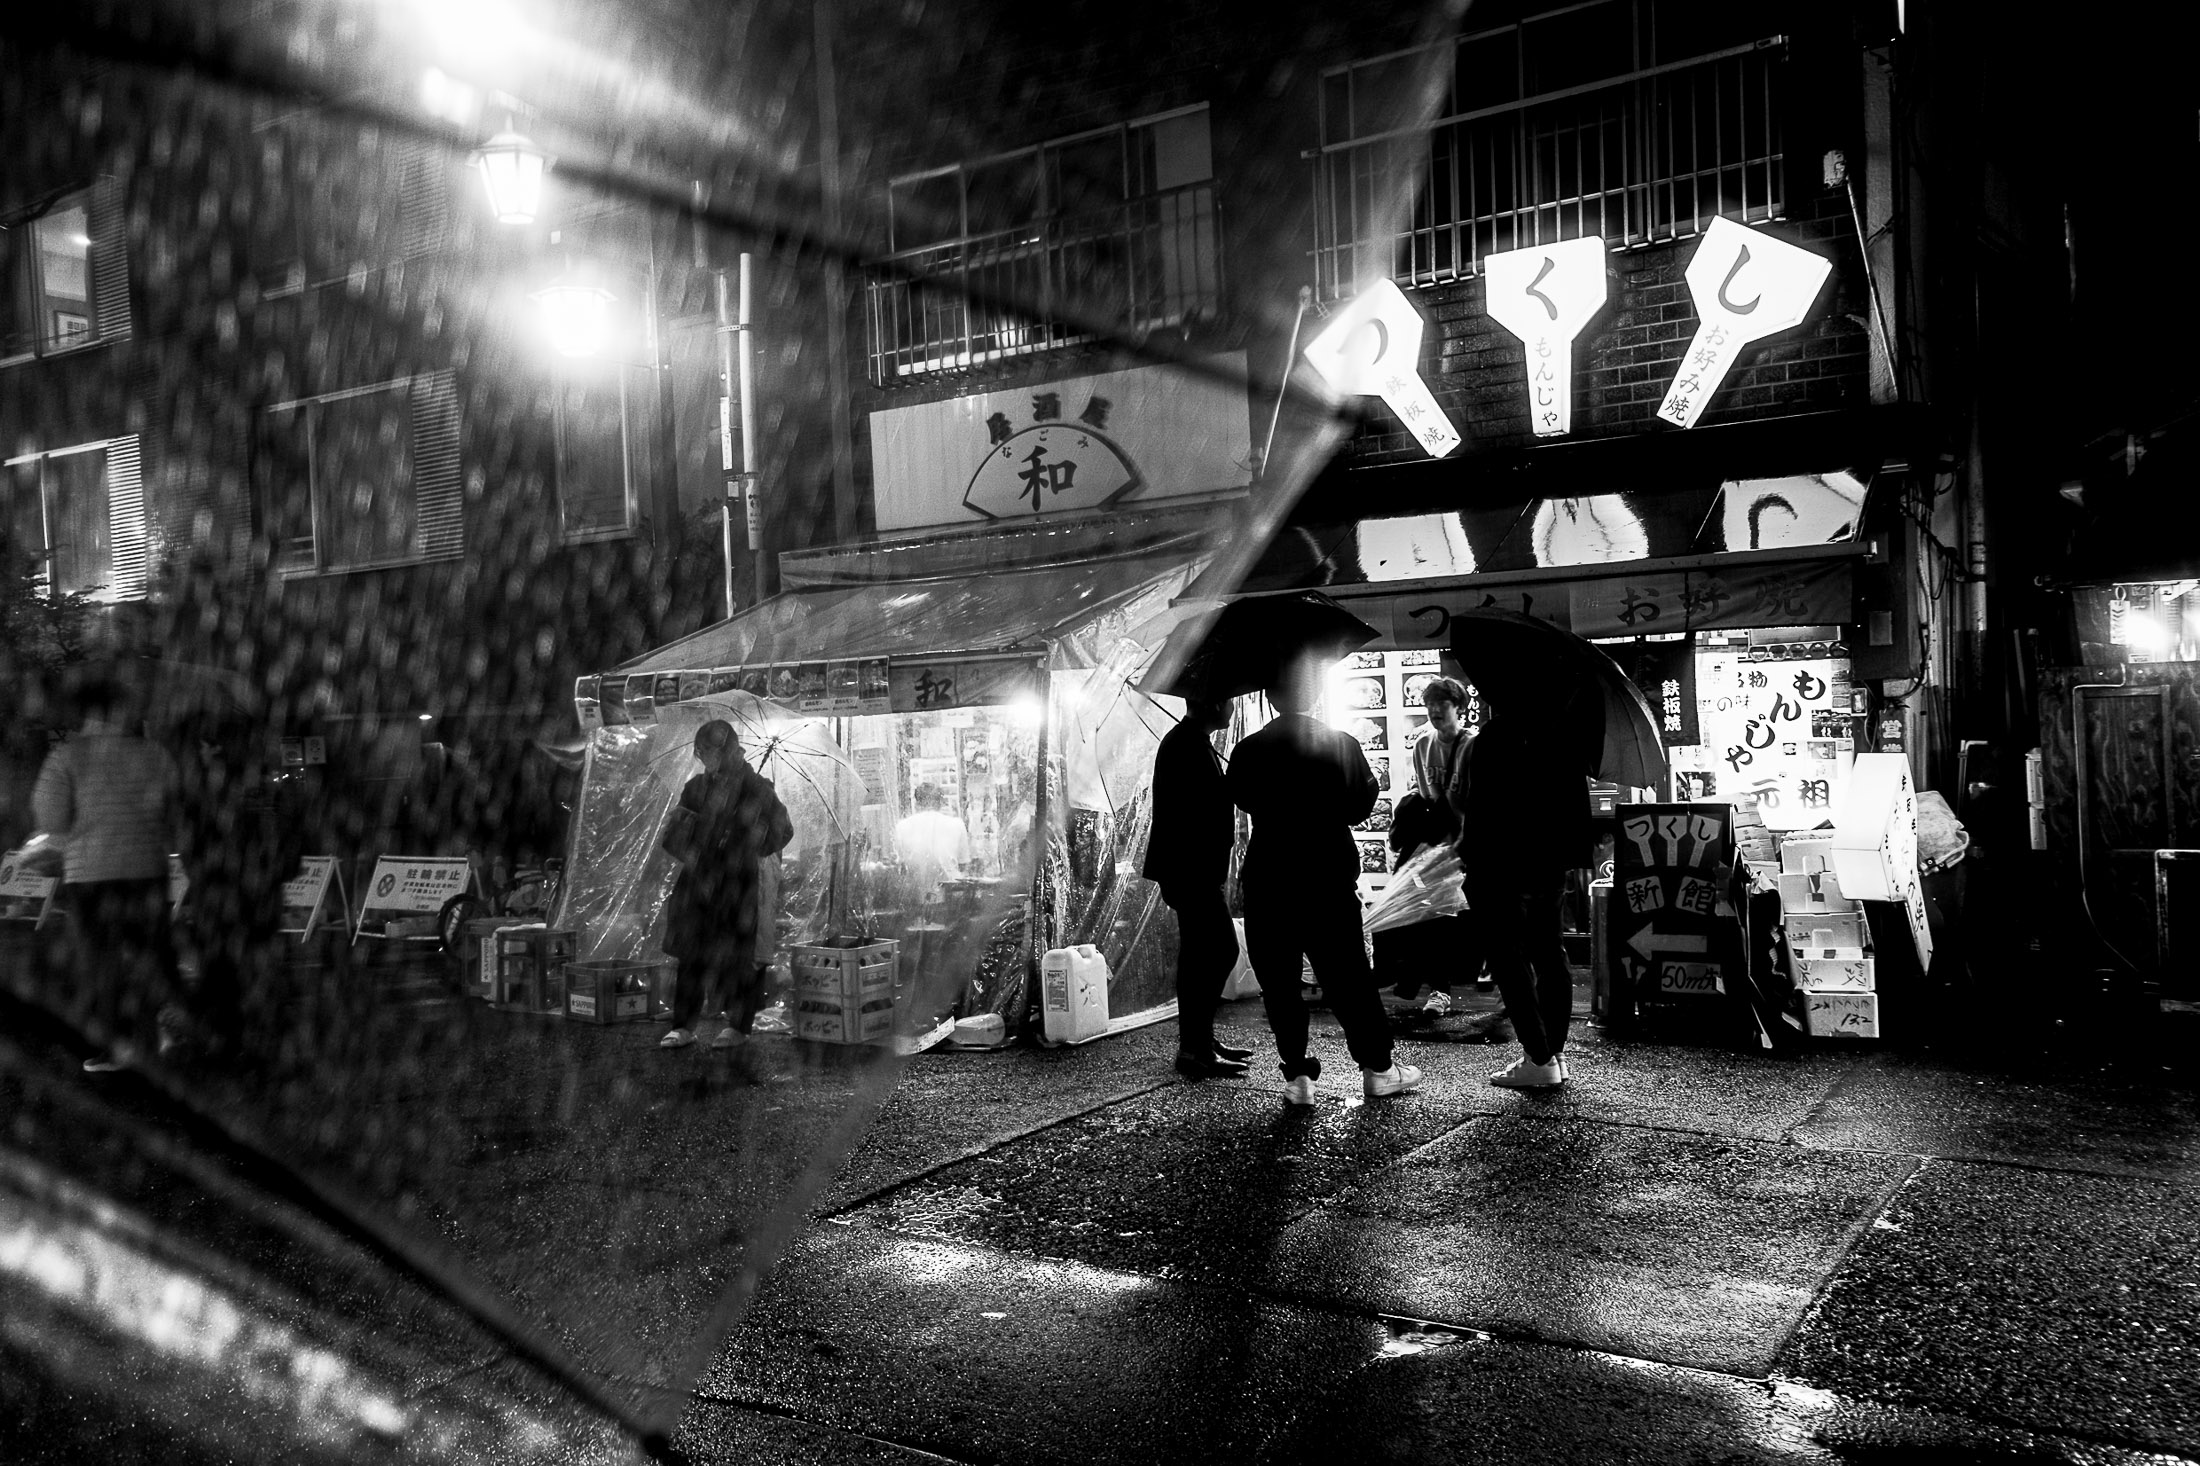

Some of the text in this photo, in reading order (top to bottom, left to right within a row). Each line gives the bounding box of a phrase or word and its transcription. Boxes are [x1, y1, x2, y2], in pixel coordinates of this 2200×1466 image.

[1524, 256, 1559, 321] く
[1718, 243, 1762, 316] し
[1385, 375, 1446, 446] 鉄板焼
[1532, 337, 1559, 428] もんじゃ
[1664, 324, 1729, 423] お好み焼
[1017, 445, 1078, 512] 和
[1661, 679, 1682, 732] 鉄板焼
[1725, 670, 1826, 773] もんじゃ
[1751, 779, 1832, 809] 元祖
